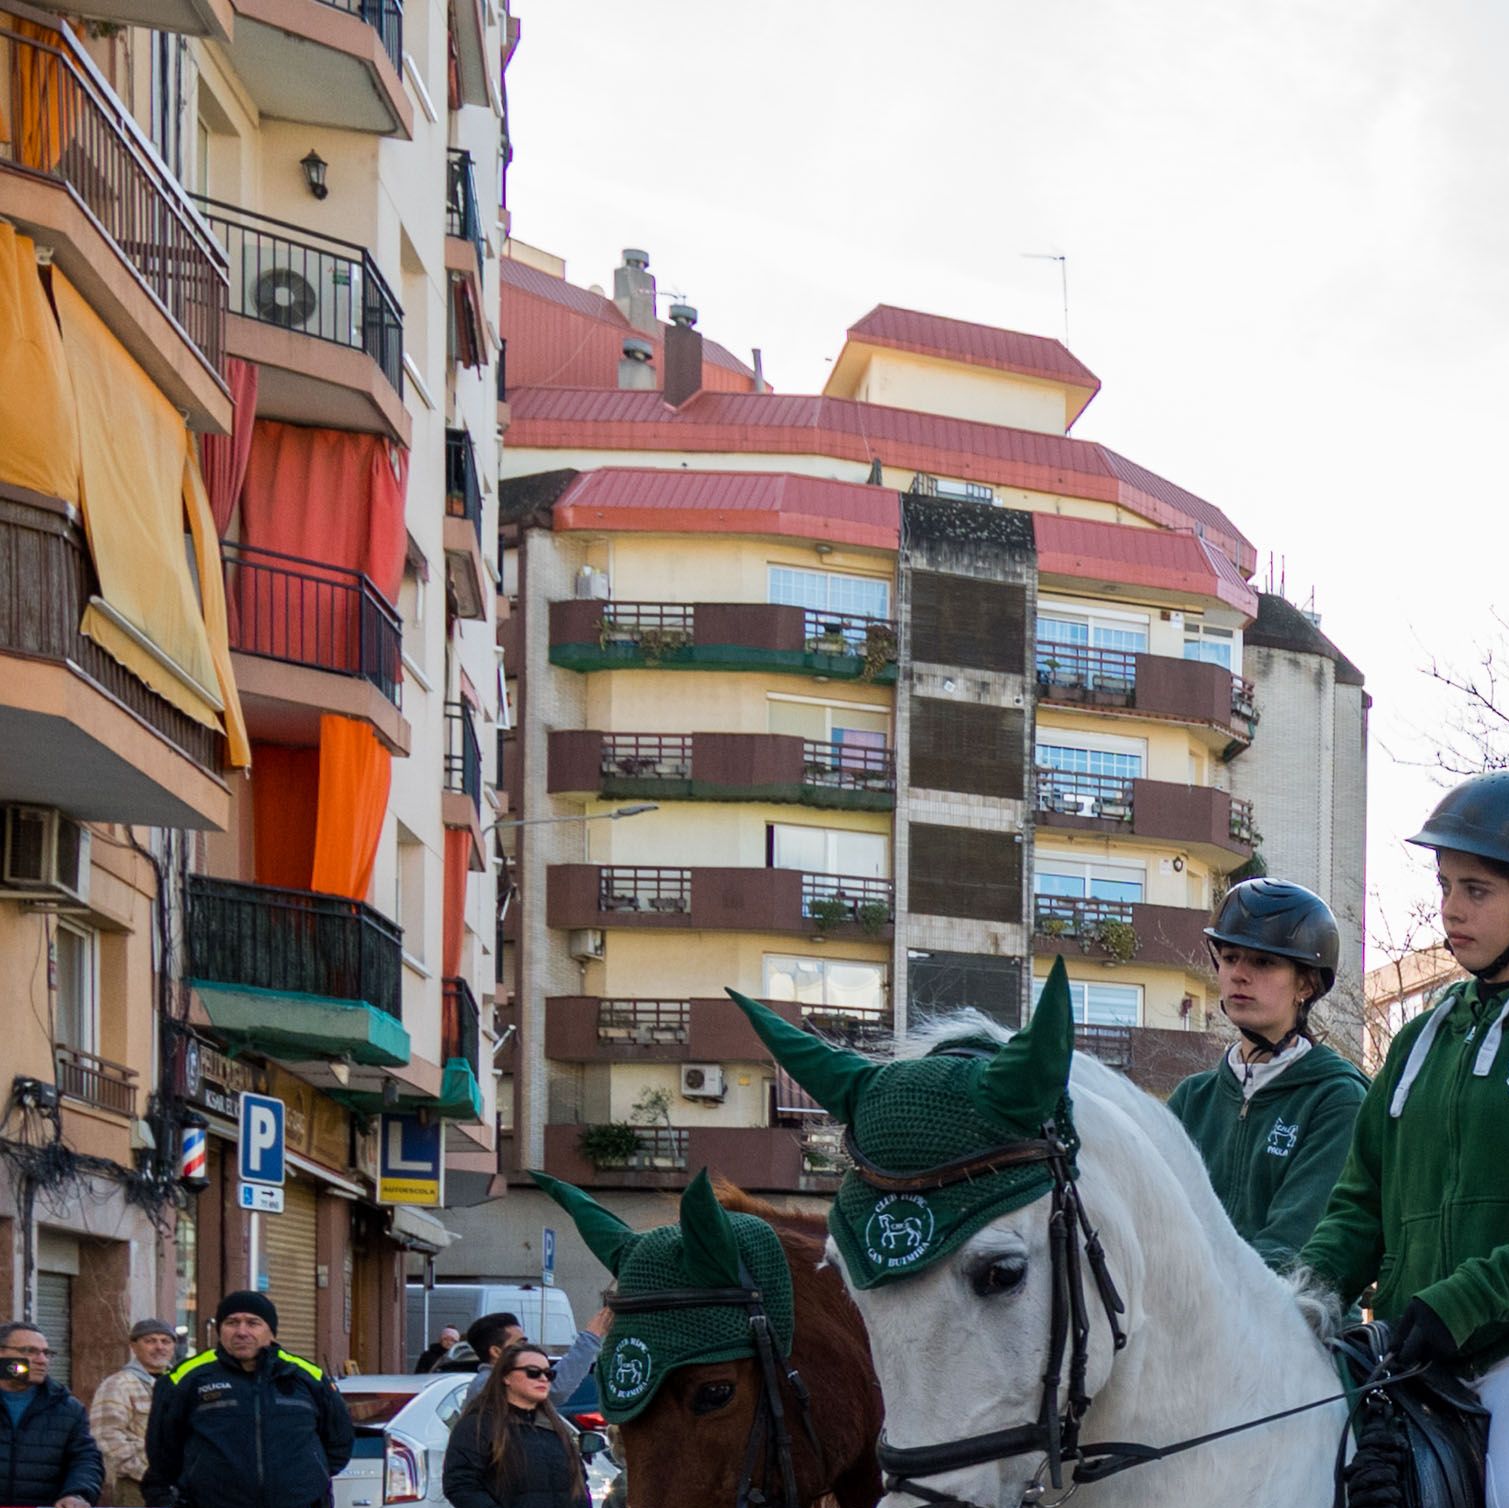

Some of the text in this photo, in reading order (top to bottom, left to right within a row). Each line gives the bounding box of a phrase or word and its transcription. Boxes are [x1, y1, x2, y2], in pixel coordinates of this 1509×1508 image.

[250, 1105, 276, 1171] P
[388, 1121, 432, 1172] L
[383, 1186, 435, 1195] AUTOESCOLA
[198, 1382, 232, 1394] POLICIA
